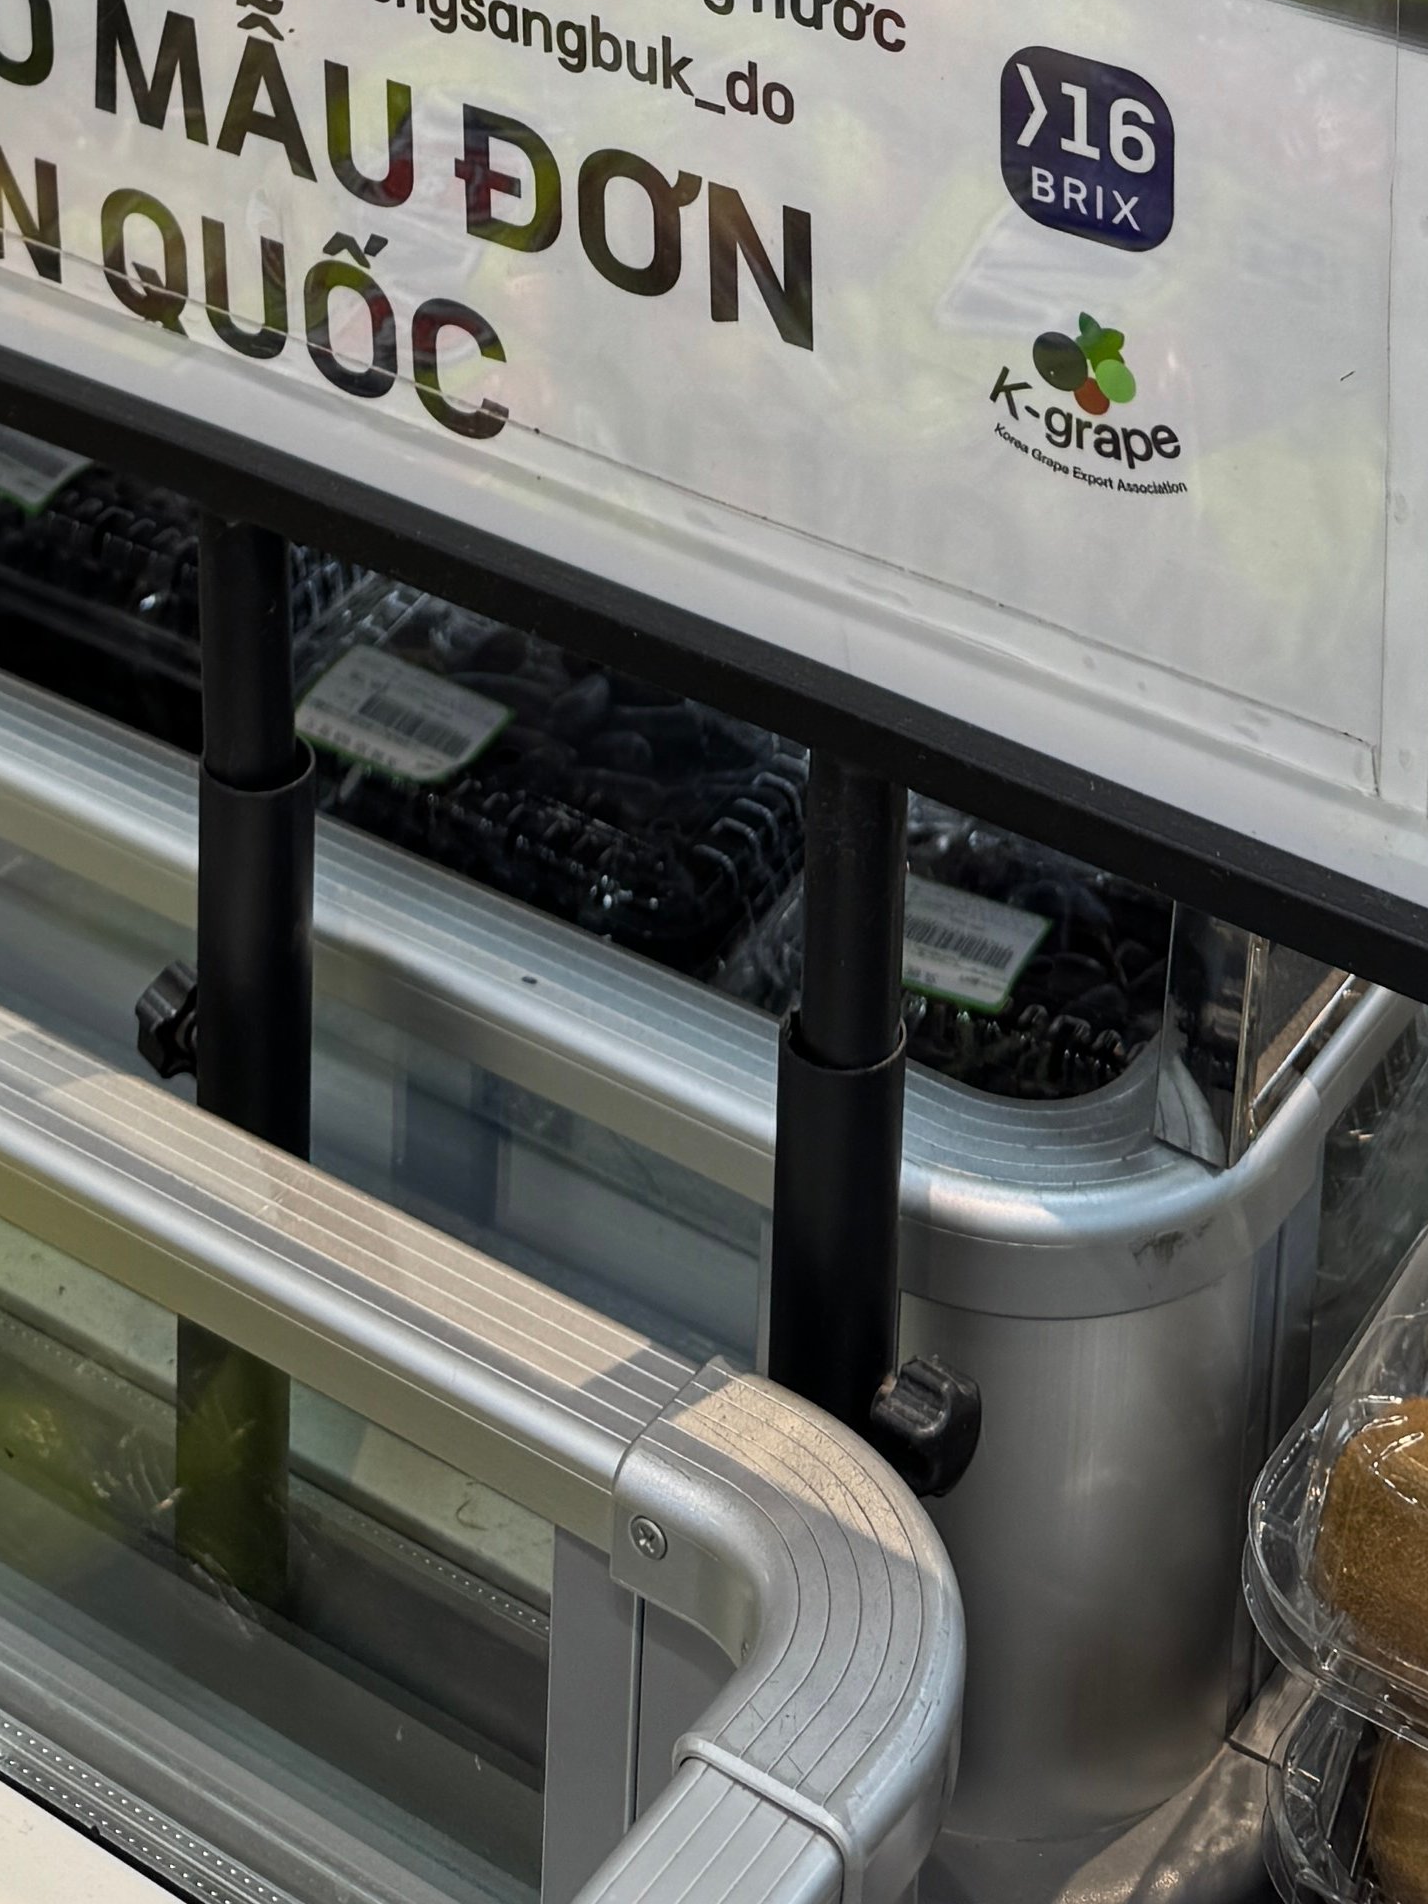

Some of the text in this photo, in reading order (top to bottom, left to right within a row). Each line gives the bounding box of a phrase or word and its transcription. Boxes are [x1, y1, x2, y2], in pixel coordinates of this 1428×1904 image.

[455, 103, 817, 352] ĐƠN
[1031, 166, 1142, 232] BRIX
[100, 188, 510, 441] QUỐC
[989, 366, 1182, 470] K-grape
[994, 423, 1029, 455] Korea
[1032, 448, 1070, 476] Grape
[1073, 467, 1114, 490] Export
